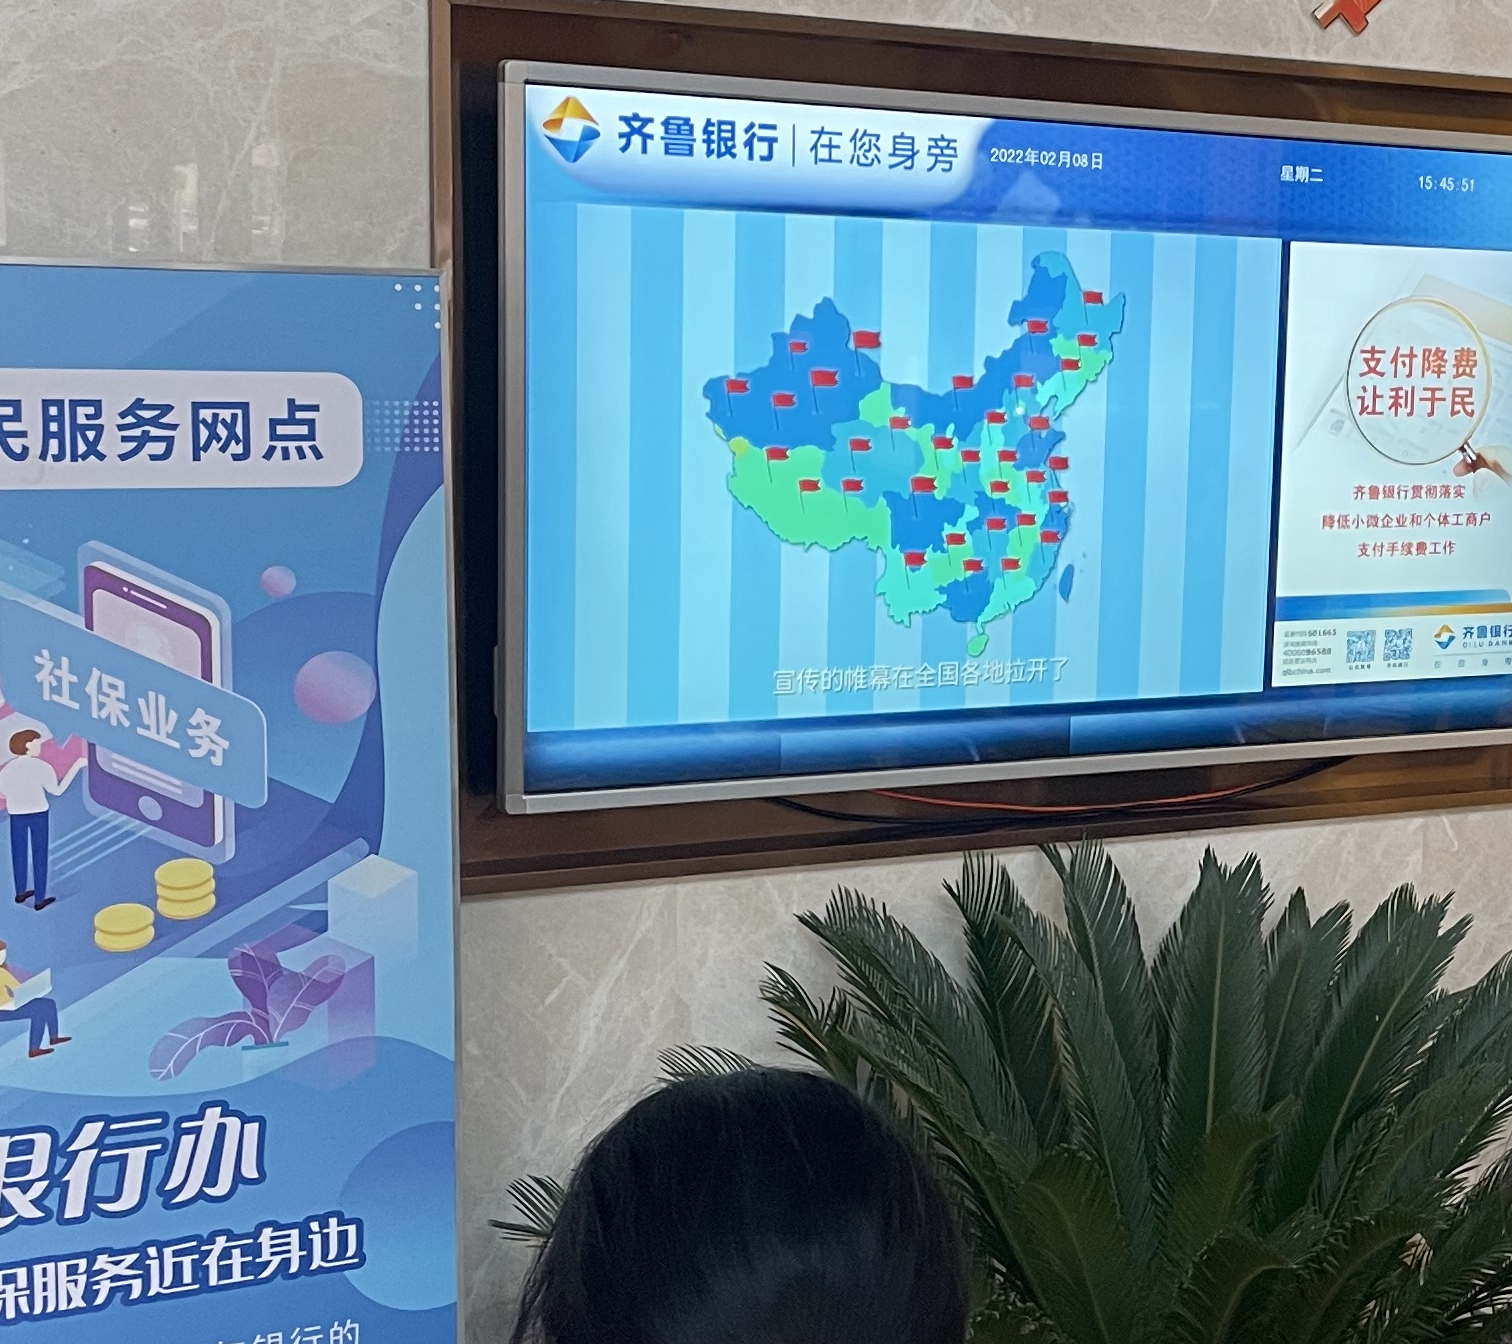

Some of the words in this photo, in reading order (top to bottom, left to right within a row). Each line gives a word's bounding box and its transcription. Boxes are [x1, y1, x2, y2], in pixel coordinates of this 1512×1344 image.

[617, 112, 779, 162] 齐鲁银行
[808, 125, 959, 173] 在您身旁
[990, 148, 1103, 170] 2022年02月08日
[1280, 166, 1324, 183] 星期二
[1418, 175, 1476, 193] 15:45:51
[1359, 345, 1478, 379] 支付降费
[1356, 385, 1475, 418] 让利于民
[0, 397, 323, 462] 民服务网点
[1352, 484, 1466, 500] 齐鲁银行贯彻落实
[1321, 512, 1491, 530] 降低小微企业和个体工商户
[1357, 540, 1456, 558] 支付手续费工作
[773, 657, 1069, 696] 宣传的帷幕在全国各地拉开了
[34, 648, 230, 768] 社保业务
